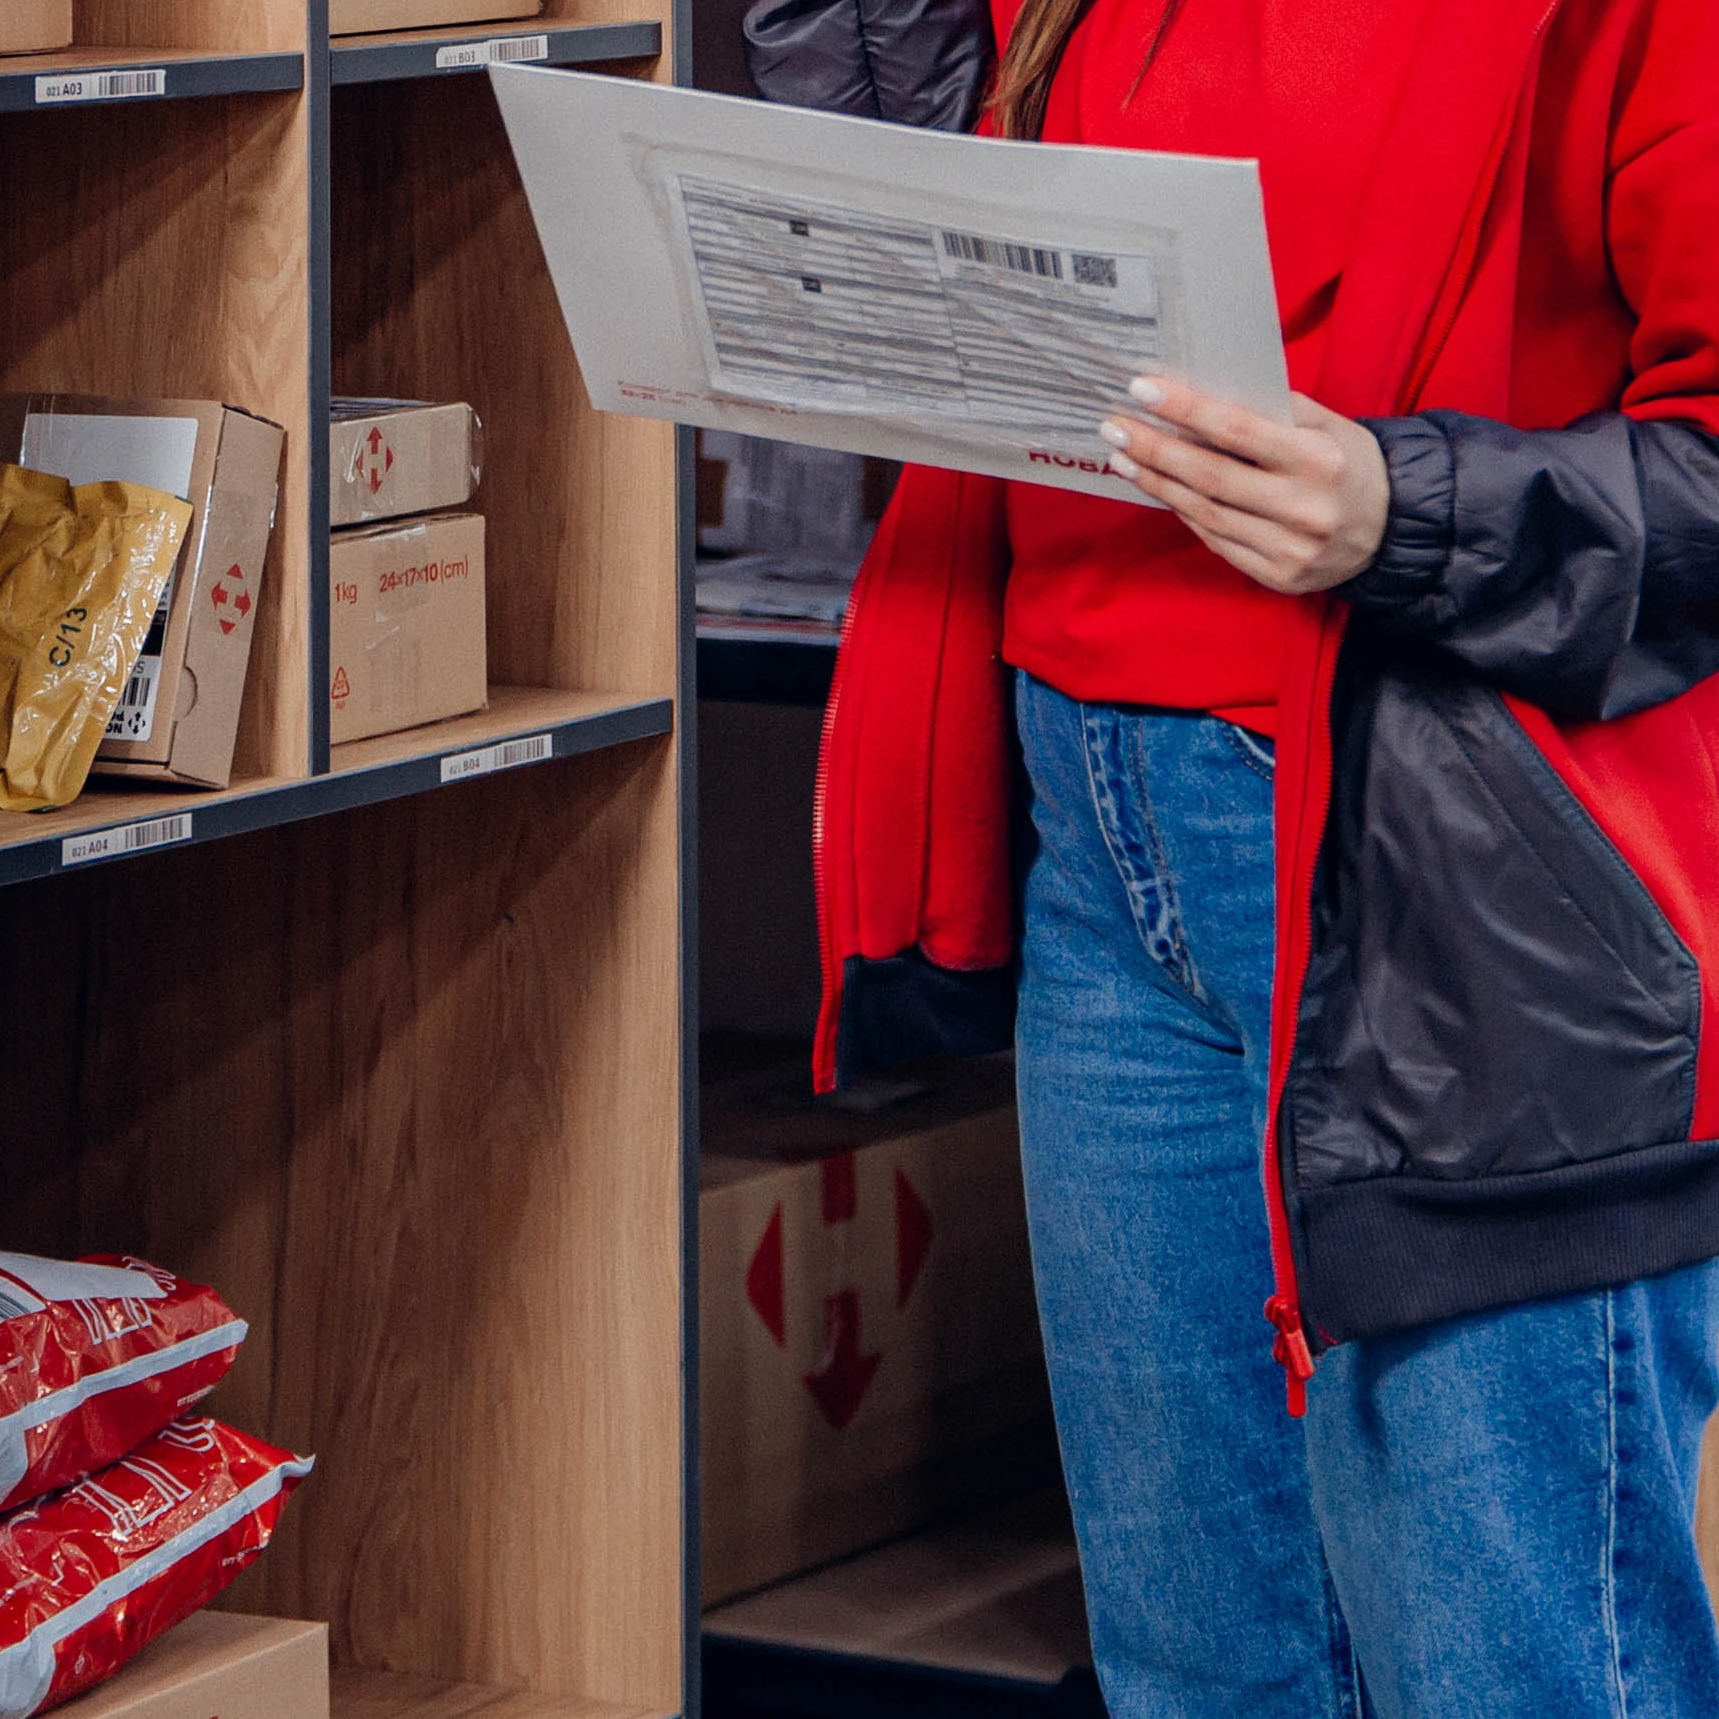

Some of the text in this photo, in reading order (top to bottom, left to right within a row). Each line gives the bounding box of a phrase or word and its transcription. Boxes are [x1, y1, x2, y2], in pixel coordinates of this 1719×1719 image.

[459, 51, 476, 64] B03
[62, 82, 83, 96] A03
[47, 606, 88, 669] C/13
[463, 757, 480, 772] B04
[88, 837, 109, 855] A04
